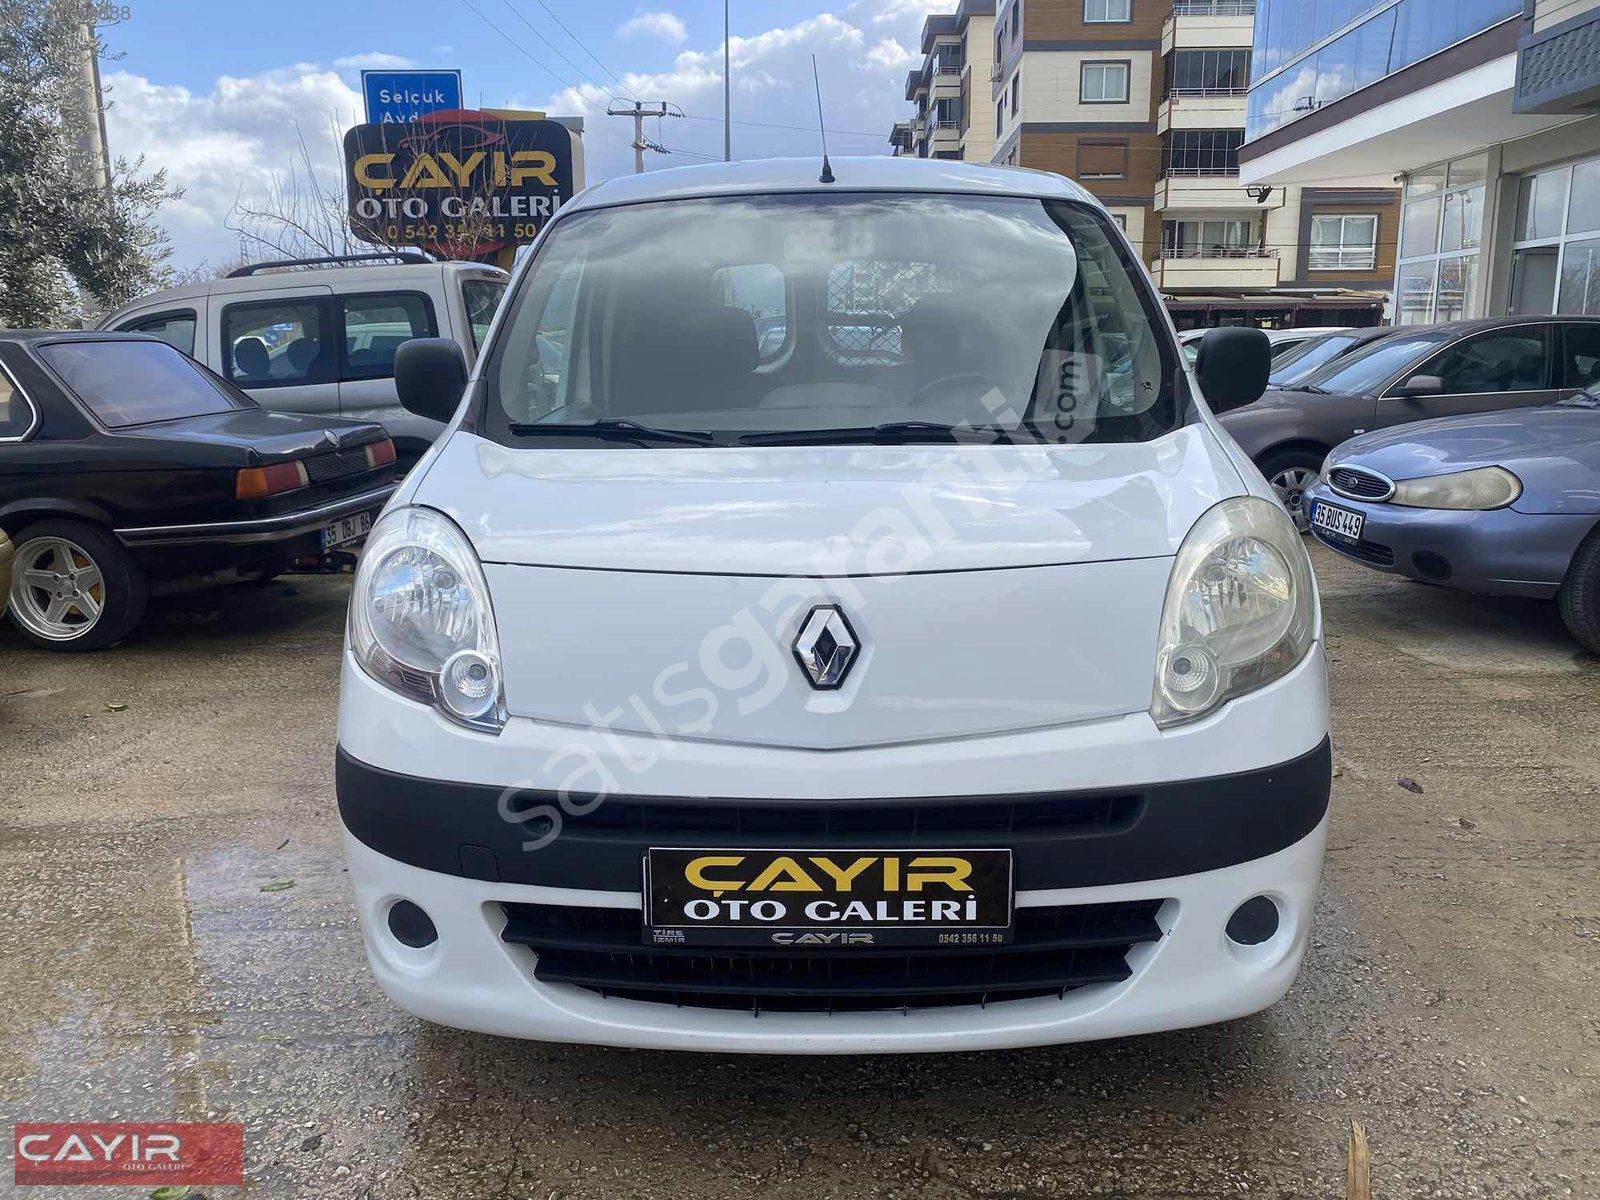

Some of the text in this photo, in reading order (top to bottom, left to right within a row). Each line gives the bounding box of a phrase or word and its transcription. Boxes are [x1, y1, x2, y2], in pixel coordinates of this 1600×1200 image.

[380, 89, 445, 105] Selçuk
[353, 150, 559, 195] ÇAYIR
[356, 188, 561, 219] OTO GALERİ
[514, 223, 536, 238] 50
[1315, 504, 1326, 524] 35
[1326, 508, 1343, 530] BUS
[1343, 513, 1361, 536] 449
[684, 856, 974, 897] ÇAYIR
[683, 894, 977, 922] OTO GALERİ
[961, 933, 978, 943] 356
